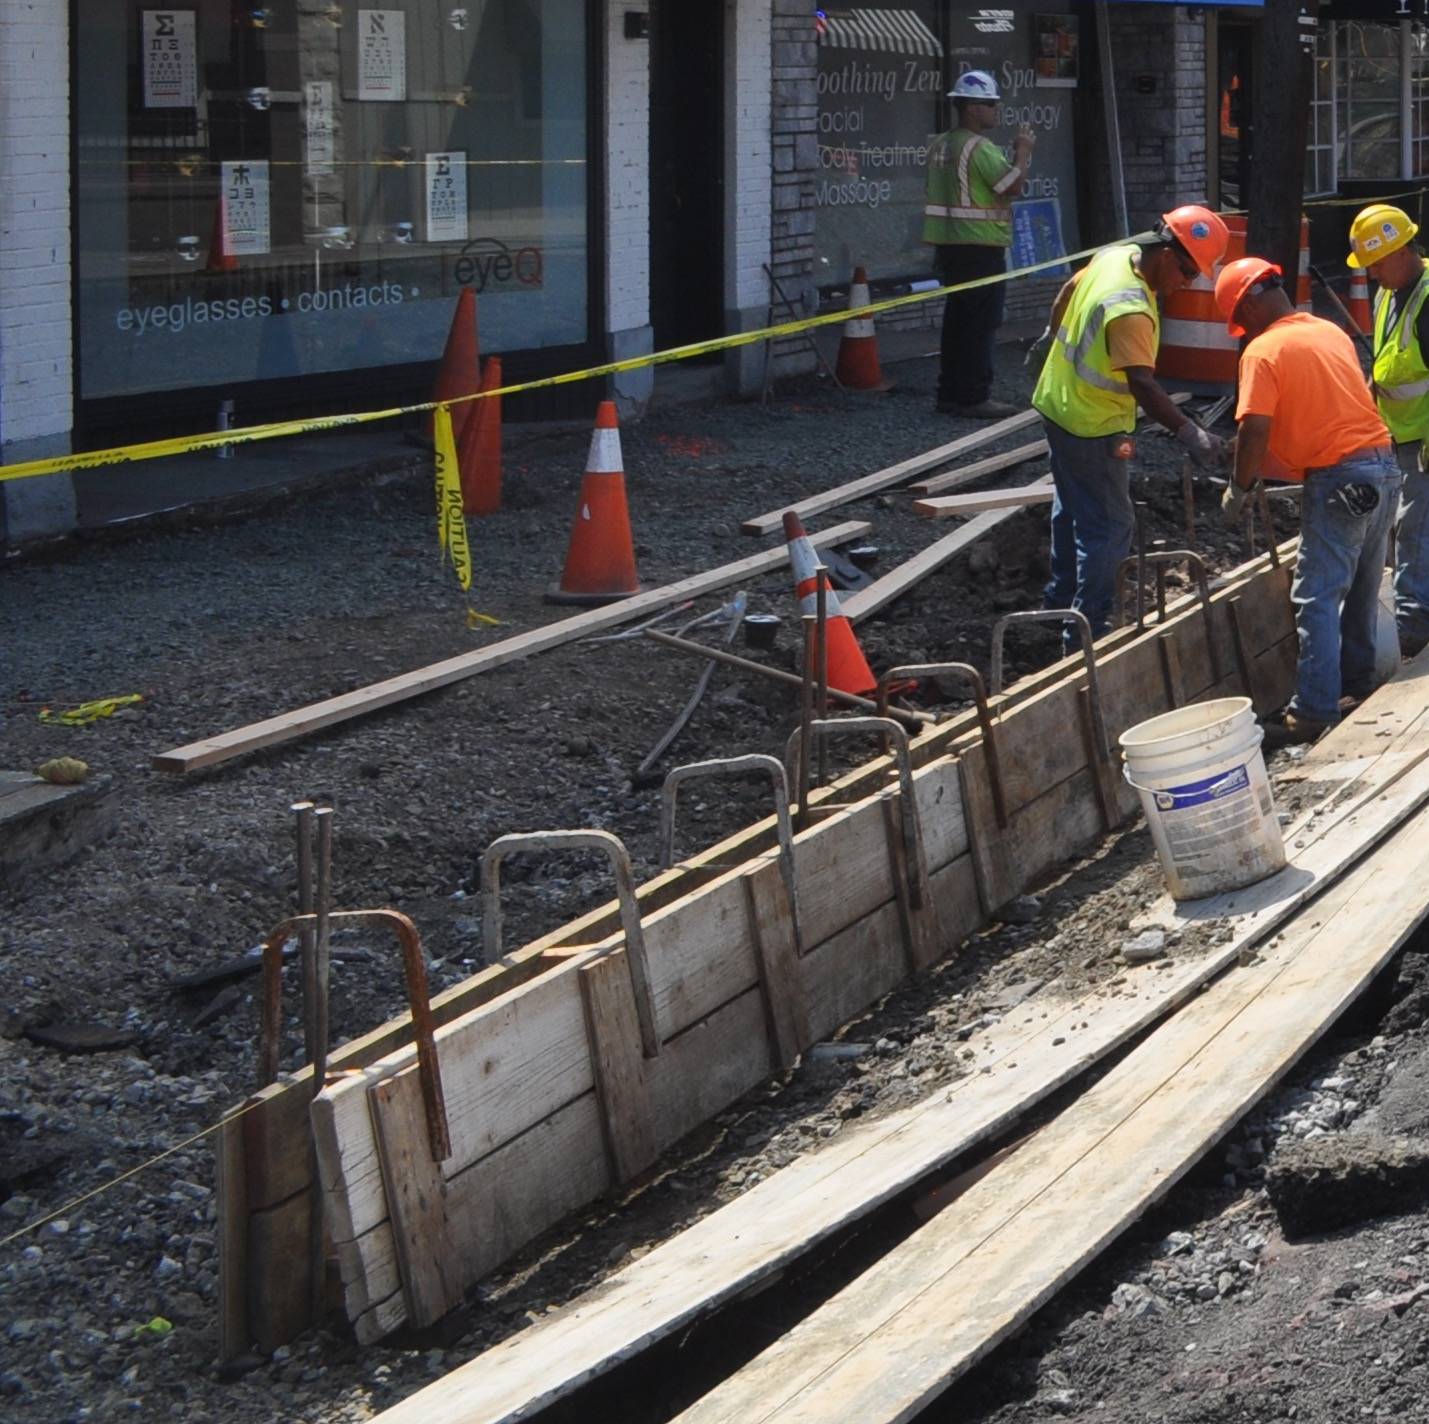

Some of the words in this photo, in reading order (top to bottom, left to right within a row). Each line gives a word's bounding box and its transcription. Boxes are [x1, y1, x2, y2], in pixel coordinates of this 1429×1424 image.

[817, 61, 897, 102] oothing
[904, 61, 942, 93] Zen
[1002, 60, 1036, 97] Spa
[1021, 177, 1060, 198] arties
[116, 292, 273, 337] eyeglasses
[297, 279, 404, 312] contacts
